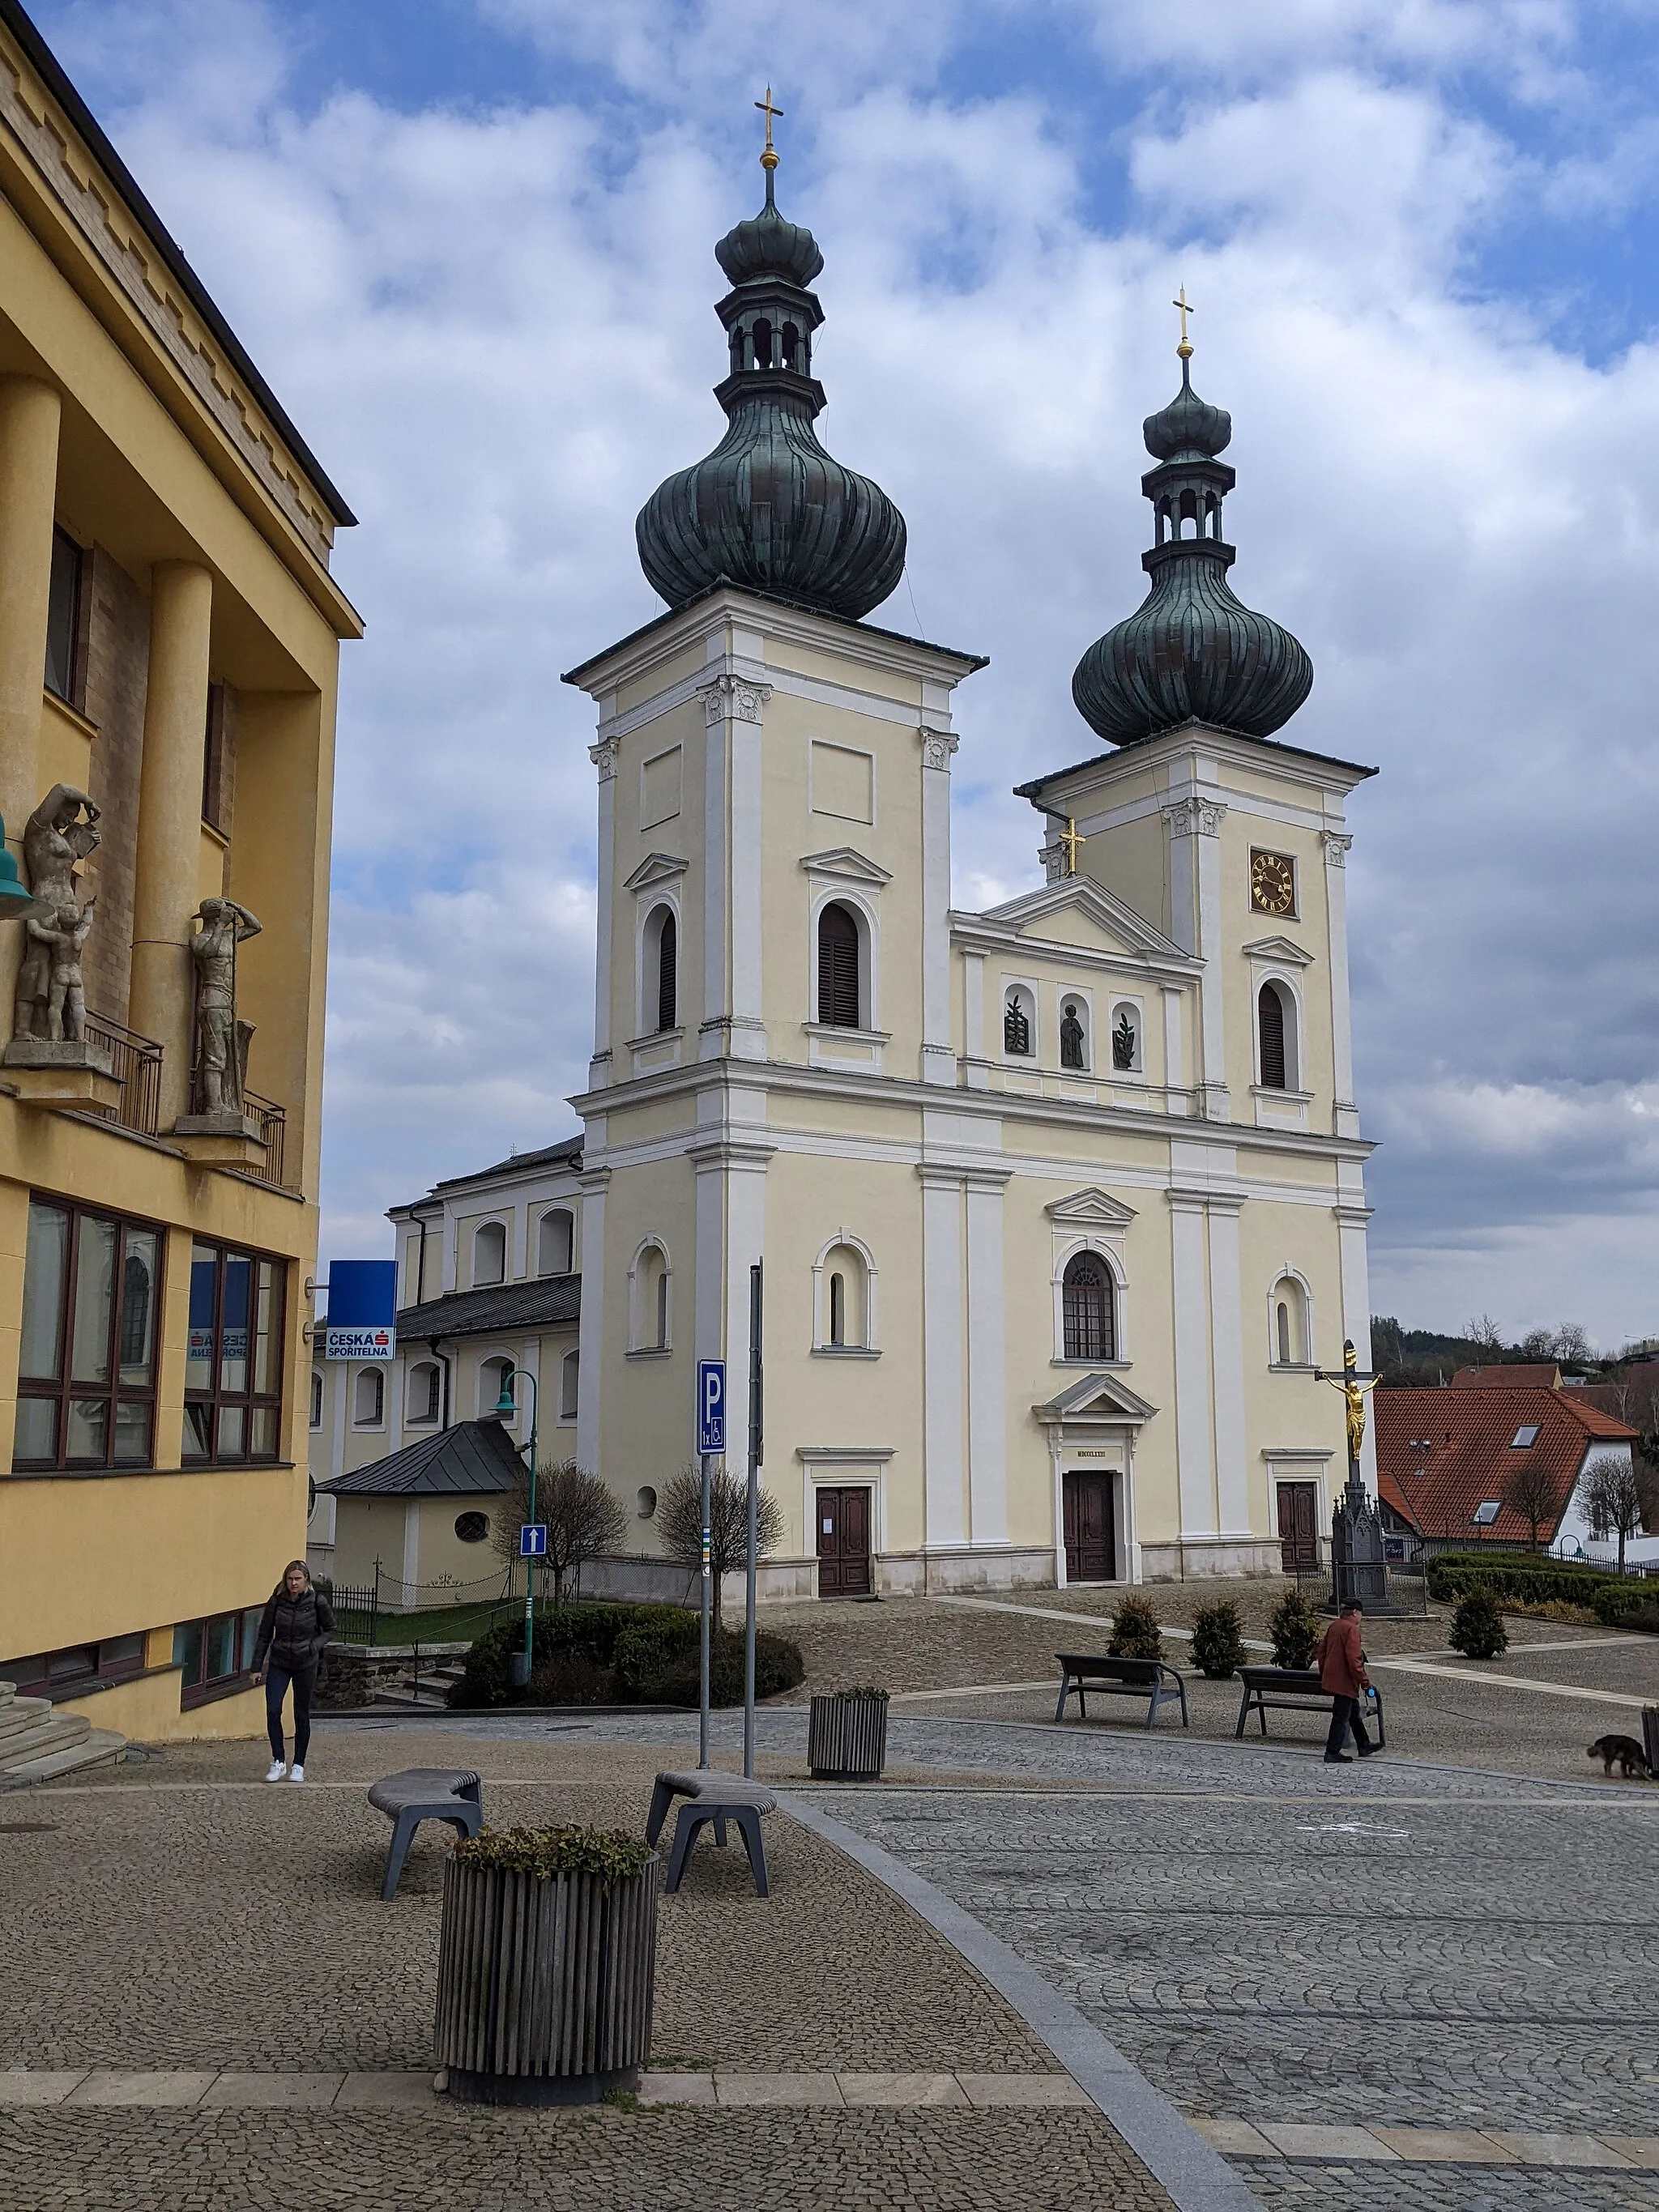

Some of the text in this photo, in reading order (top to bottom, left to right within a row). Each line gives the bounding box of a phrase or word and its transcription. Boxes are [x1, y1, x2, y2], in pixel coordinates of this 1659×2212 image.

[329, 1331, 374, 1345] ČESKÁ
[328, 1345, 389, 1357] SPOŘITELNA
[706, 1372, 721, 1424] P
[702, 1430, 710, 1446] 1x
